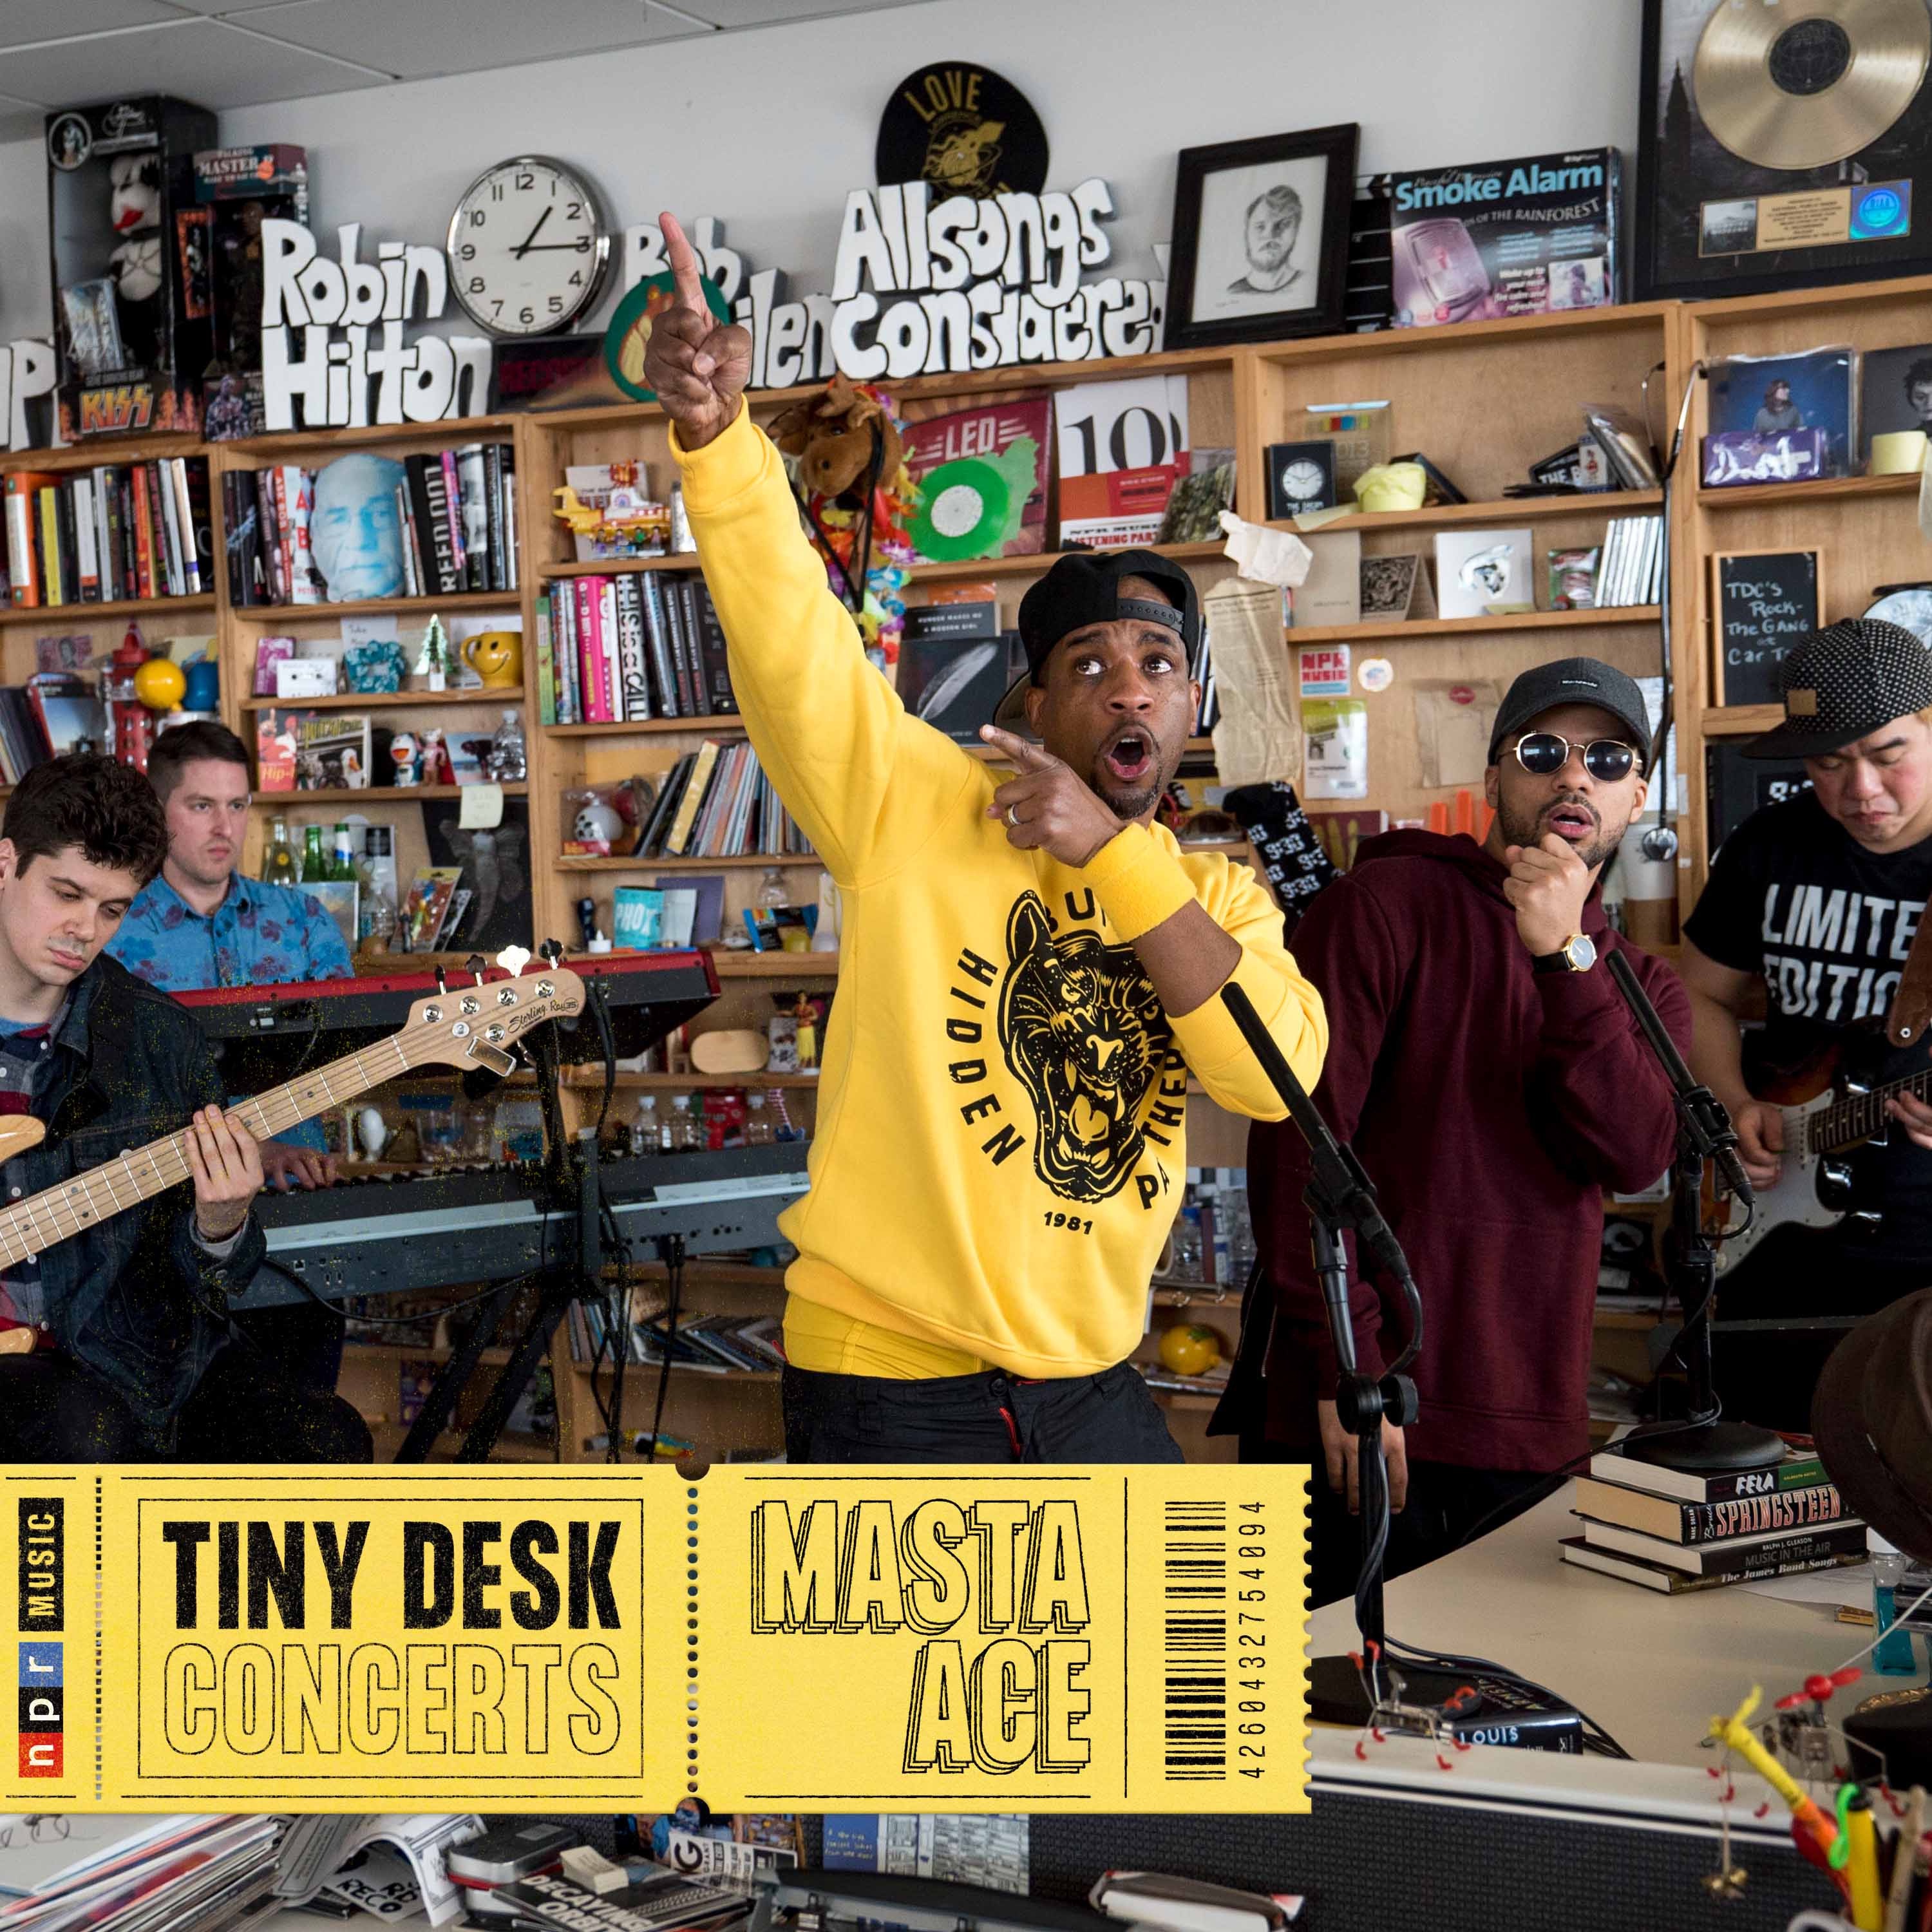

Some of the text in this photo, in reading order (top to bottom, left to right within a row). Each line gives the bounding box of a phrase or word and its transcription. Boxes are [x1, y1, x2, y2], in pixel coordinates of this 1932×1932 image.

[904, 71, 983, 121] LOVE
[198, 156, 259, 176] MASTER
[516, 174, 534, 190] 12
[551, 181, 556, 196] 1
[1396, 173, 1502, 211] Smoke
[1504, 164, 1603, 198] Alarm
[491, 185, 504, 202] 11
[469, 210, 486, 227] 10
[567, 203, 581, 220] 2
[1515, 196, 1600, 222] RAINFOREST
[461, 245, 476, 261] 9
[831, 177, 1115, 309] Allsongs
[261, 218, 448, 328] Robin
[568, 270, 583, 288] 4
[470, 276, 486, 294] 8
[491, 300, 504, 317] 7
[519, 307, 534, 324] 6
[548, 296, 563, 314] 5
[261, 321, 493, 430] Hilton
[80, 384, 154, 433] KISS
[1725, 618, 1809, 637] The GANG
[1302, 652, 1346, 670] NPR
[1727, 647, 1765, 666] Car
[1761, 883, 1927, 961] LIMITE
[1762, 952, 1902, 1021] EDITIO
[946, 947, 1026, 1166] HIDDEN
[1043, 1211, 1093, 1235] 1981
[1735, 1472, 1775, 1495] FELA
[1716, 1486, 1841, 1537] SPRINGSTEEN
[1786, 1537, 1813, 1548] GLEASON
[1745, 1542, 1832, 1567] MUSIC IN THE AIR
[1720, 1571, 1741, 1584] The
[1743, 1567, 1775, 1581] James
[1778, 1563, 1805, 1575] Bond
[1808, 1557, 1838, 1571] Songs
[520, 1874, 655, 1932] DECAYING
